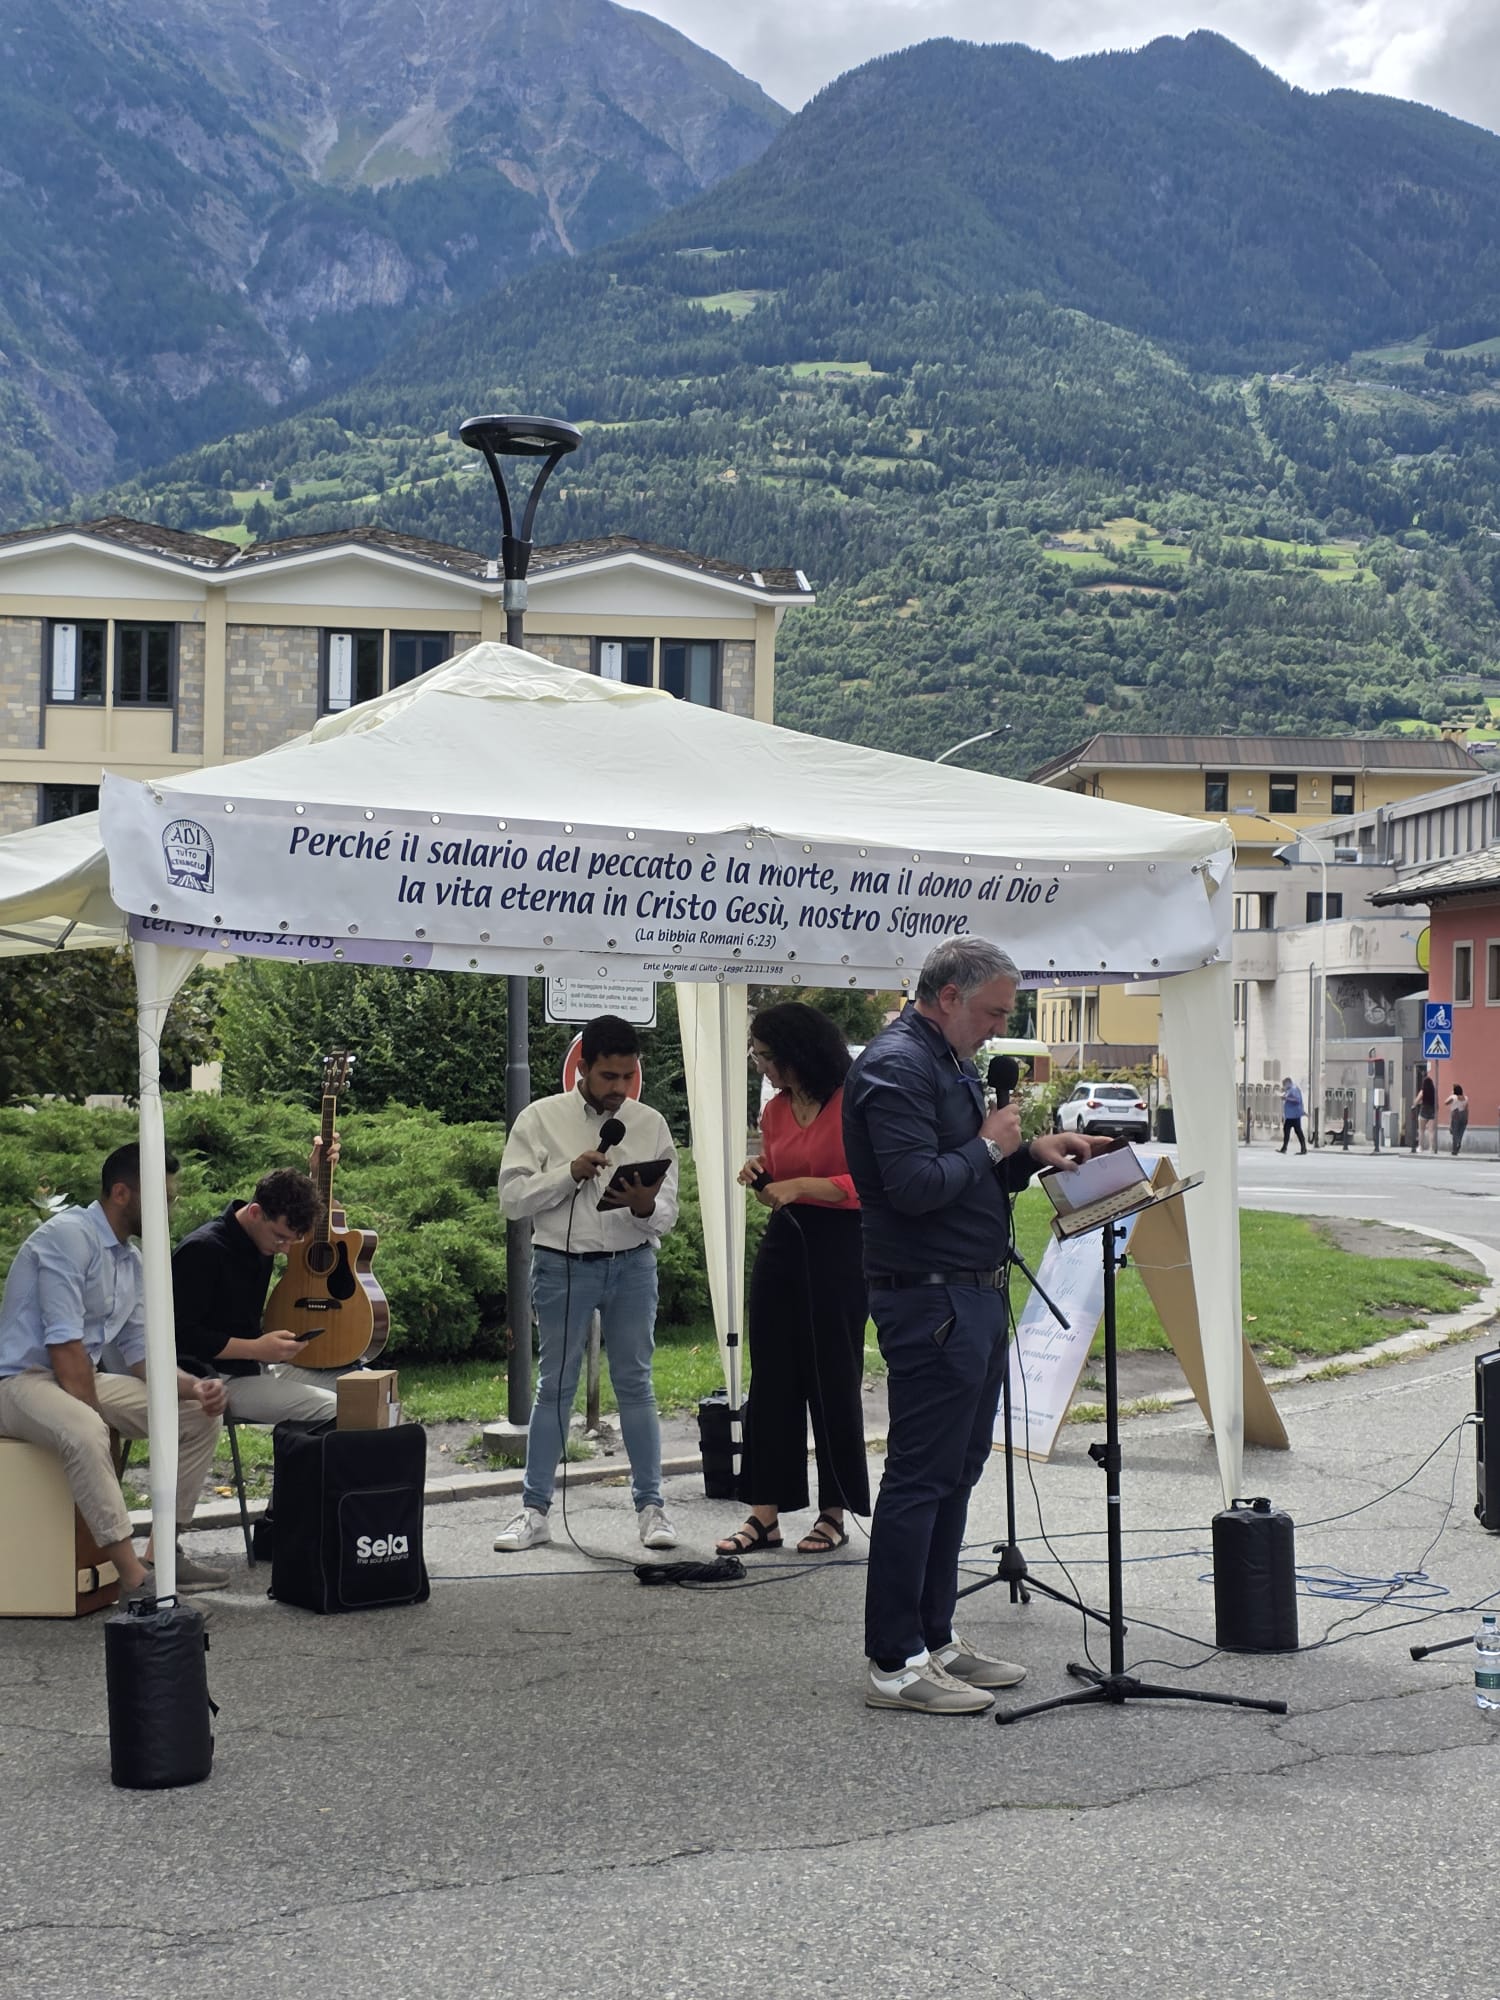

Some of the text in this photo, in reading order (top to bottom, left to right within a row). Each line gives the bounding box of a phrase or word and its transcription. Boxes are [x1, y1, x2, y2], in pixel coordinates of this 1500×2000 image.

[171, 827, 200, 845] ADI
[176, 849, 197, 859] TUTTO
[289, 826, 1060, 904] Perché il salario del peccato è la morte, ma il dono di Dio è
[398, 875, 971, 938] la vita eterna in Cristo Gesù, nostro Signore.
[635, 928, 777, 949] (La bibbia Romani 6:23)
[356, 1533, 409, 1558] Sela
